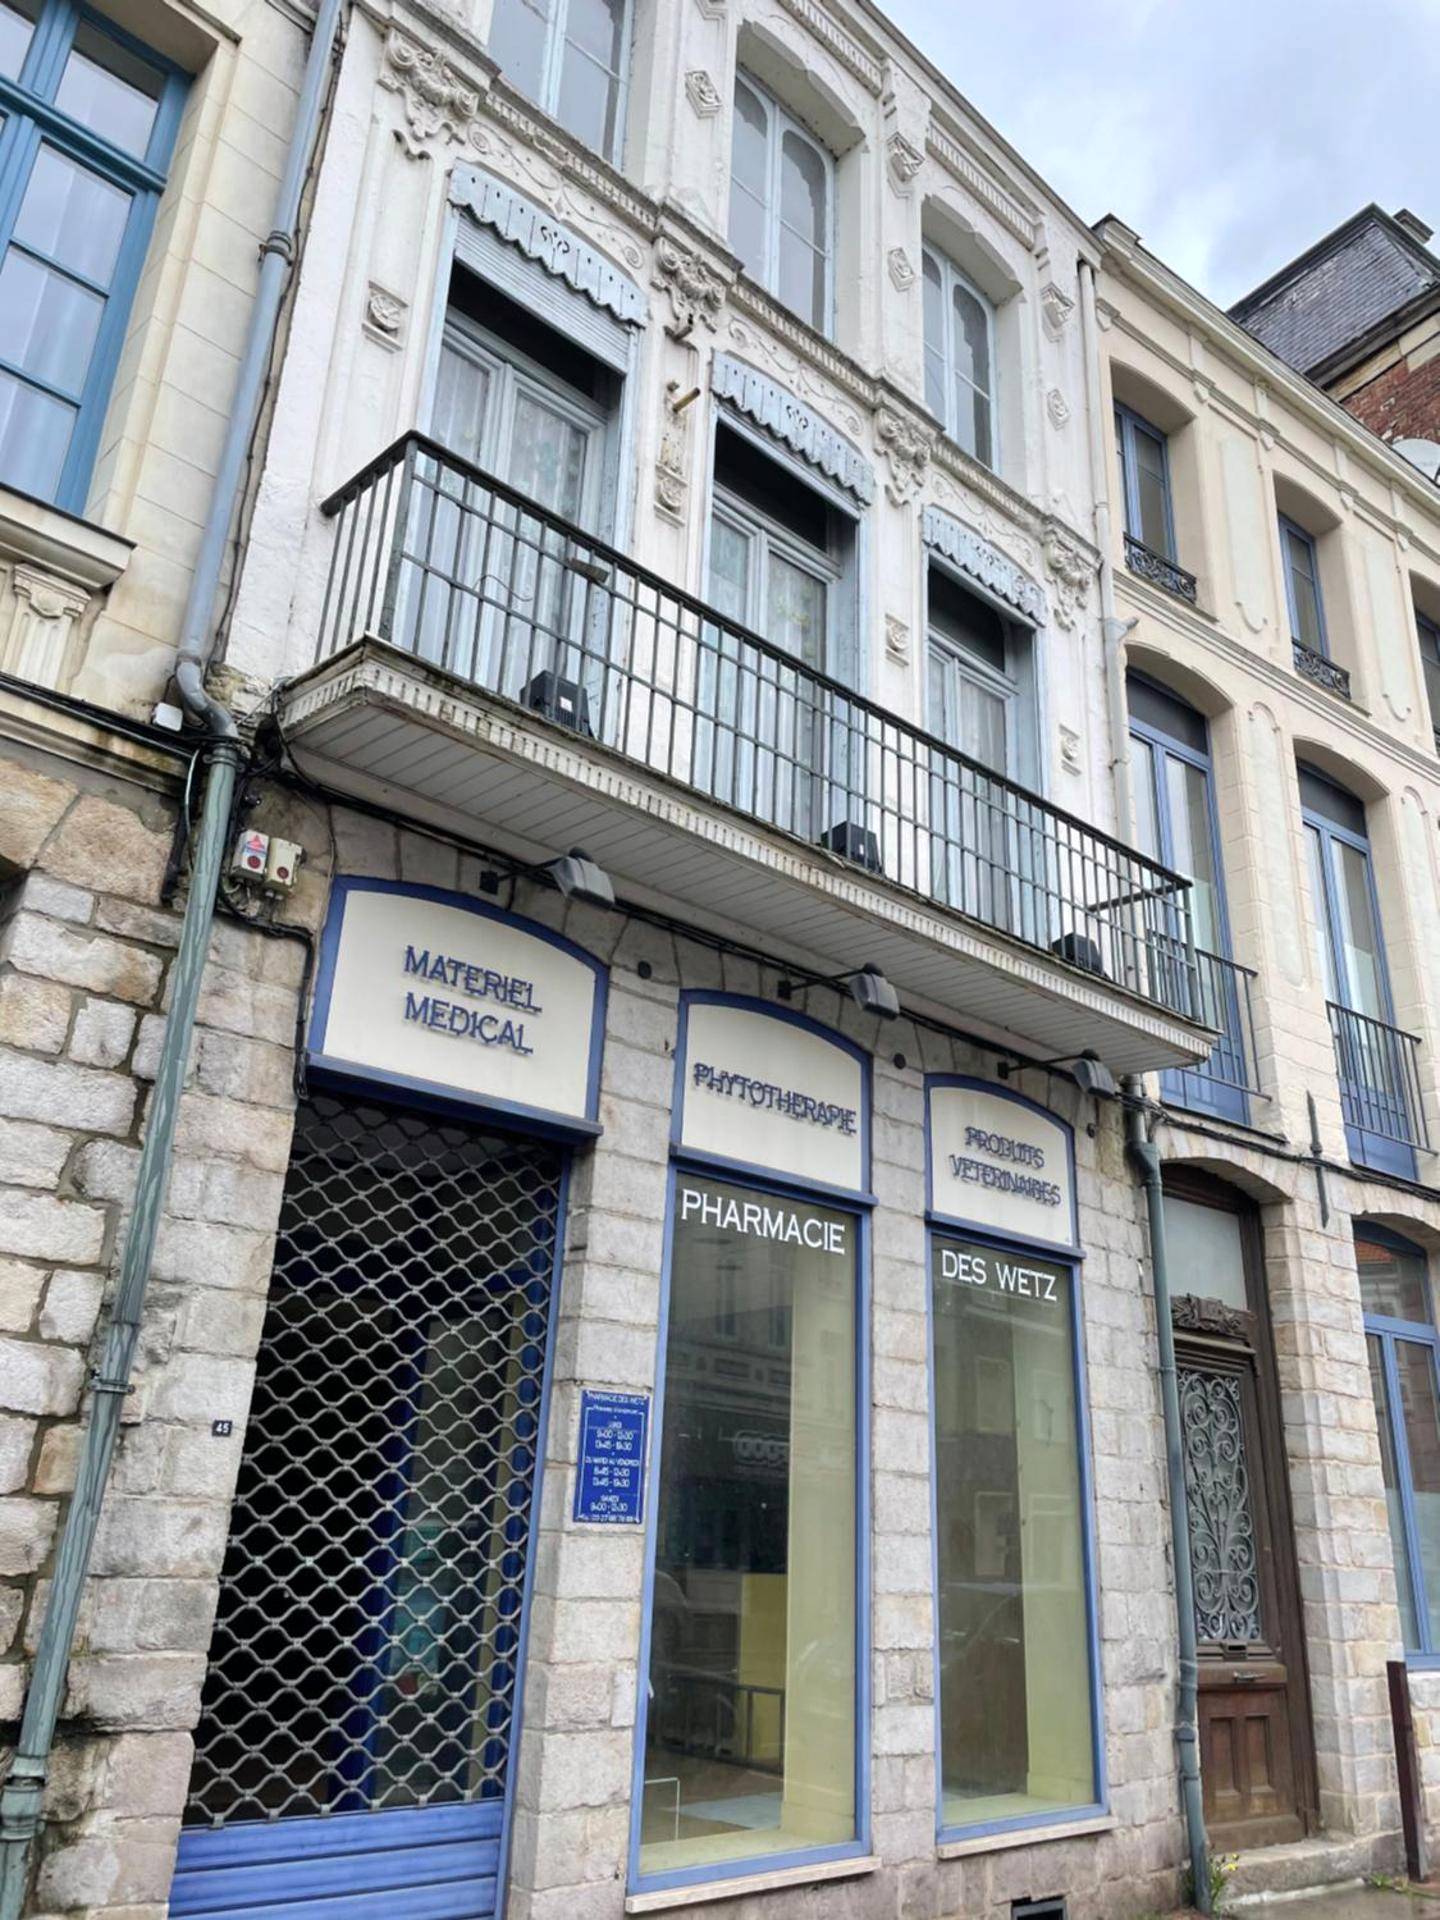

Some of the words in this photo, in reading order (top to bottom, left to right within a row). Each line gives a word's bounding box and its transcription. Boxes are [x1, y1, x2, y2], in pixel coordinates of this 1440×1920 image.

[403, 945, 542, 1013] MATERIEL
[404, 992, 533, 1054] MEDICAL
[693, 1063, 857, 1135] PHYTOTHERAPIE
[964, 1126, 1045, 1169] PRODUITS
[949, 1154, 1061, 1206] VETERINAIRES
[681, 1188, 846, 1255] PHARMACIE
[942, 1249, 987, 1285] DES
[996, 1262, 1057, 1301] WETZ
[216, 1422, 230, 1433] 45
